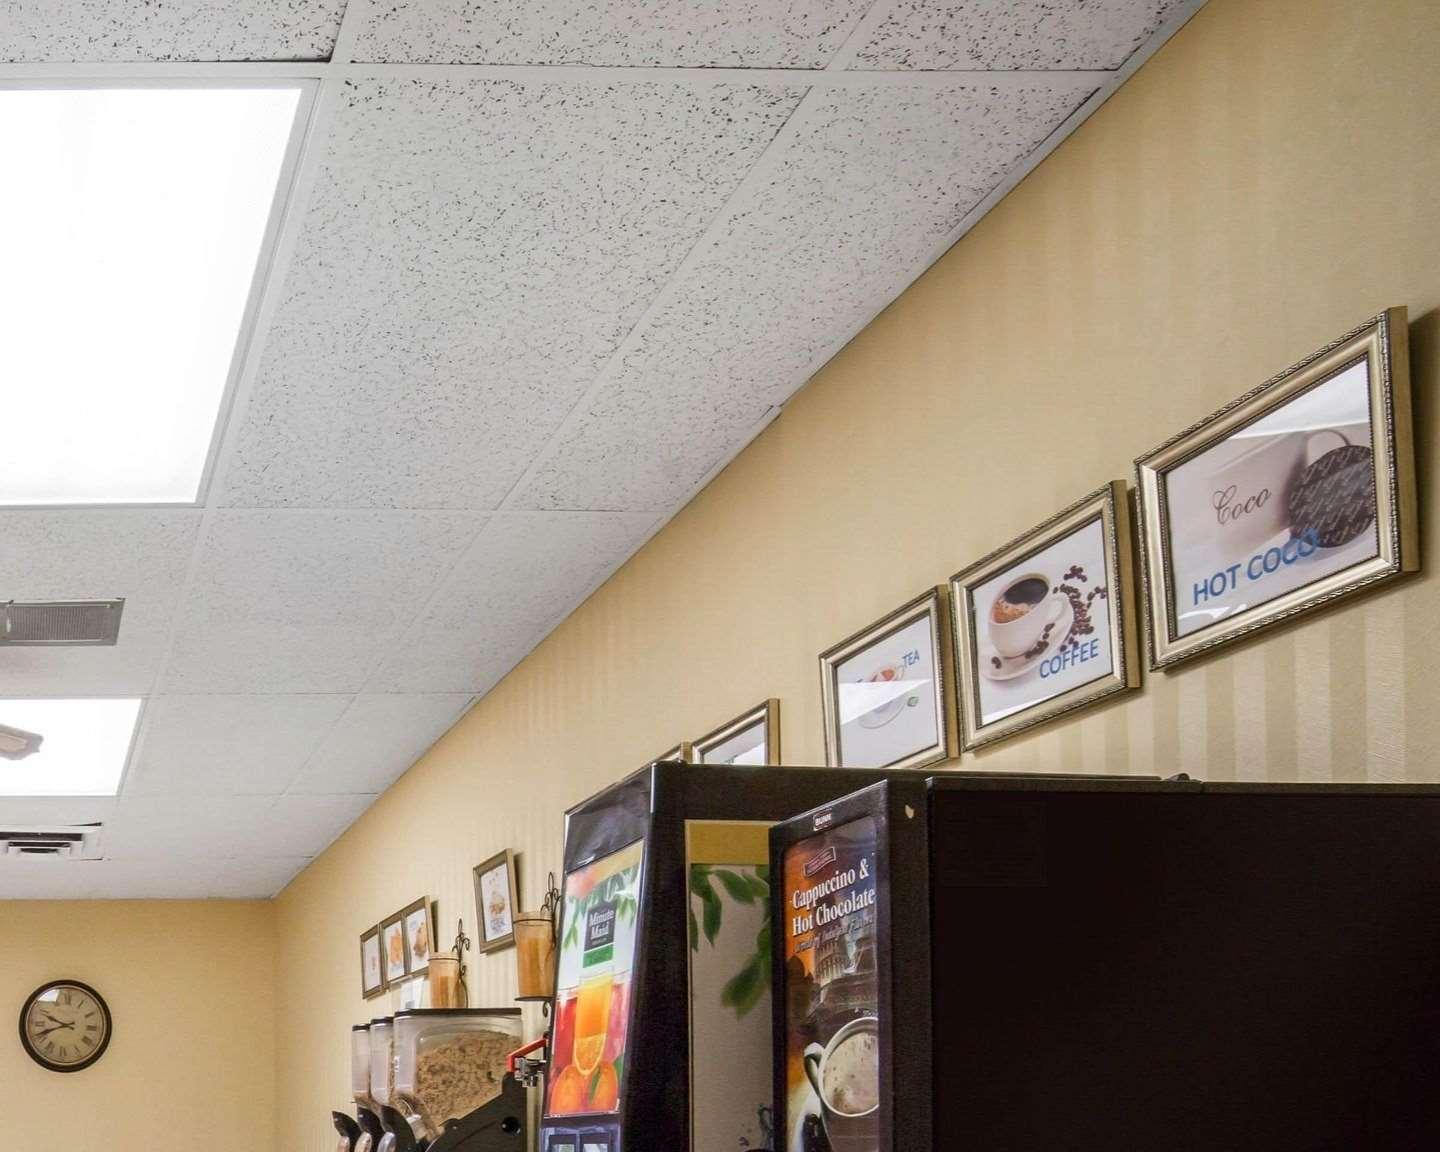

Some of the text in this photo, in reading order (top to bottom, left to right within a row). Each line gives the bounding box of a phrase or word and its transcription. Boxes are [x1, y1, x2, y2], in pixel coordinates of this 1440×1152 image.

[1213, 485, 1271, 525] Coco
[1193, 527, 1321, 605] HOT COCO
[902, 651, 921, 668] TEA
[1039, 638, 1100, 680] COFFEE
[792, 867, 856, 911] Cappuccino
[859, 858, 870, 880] &
[589, 909, 615, 928] Minute
[792, 914, 814, 937] Hot
[815, 887, 876, 926] Chocolate
